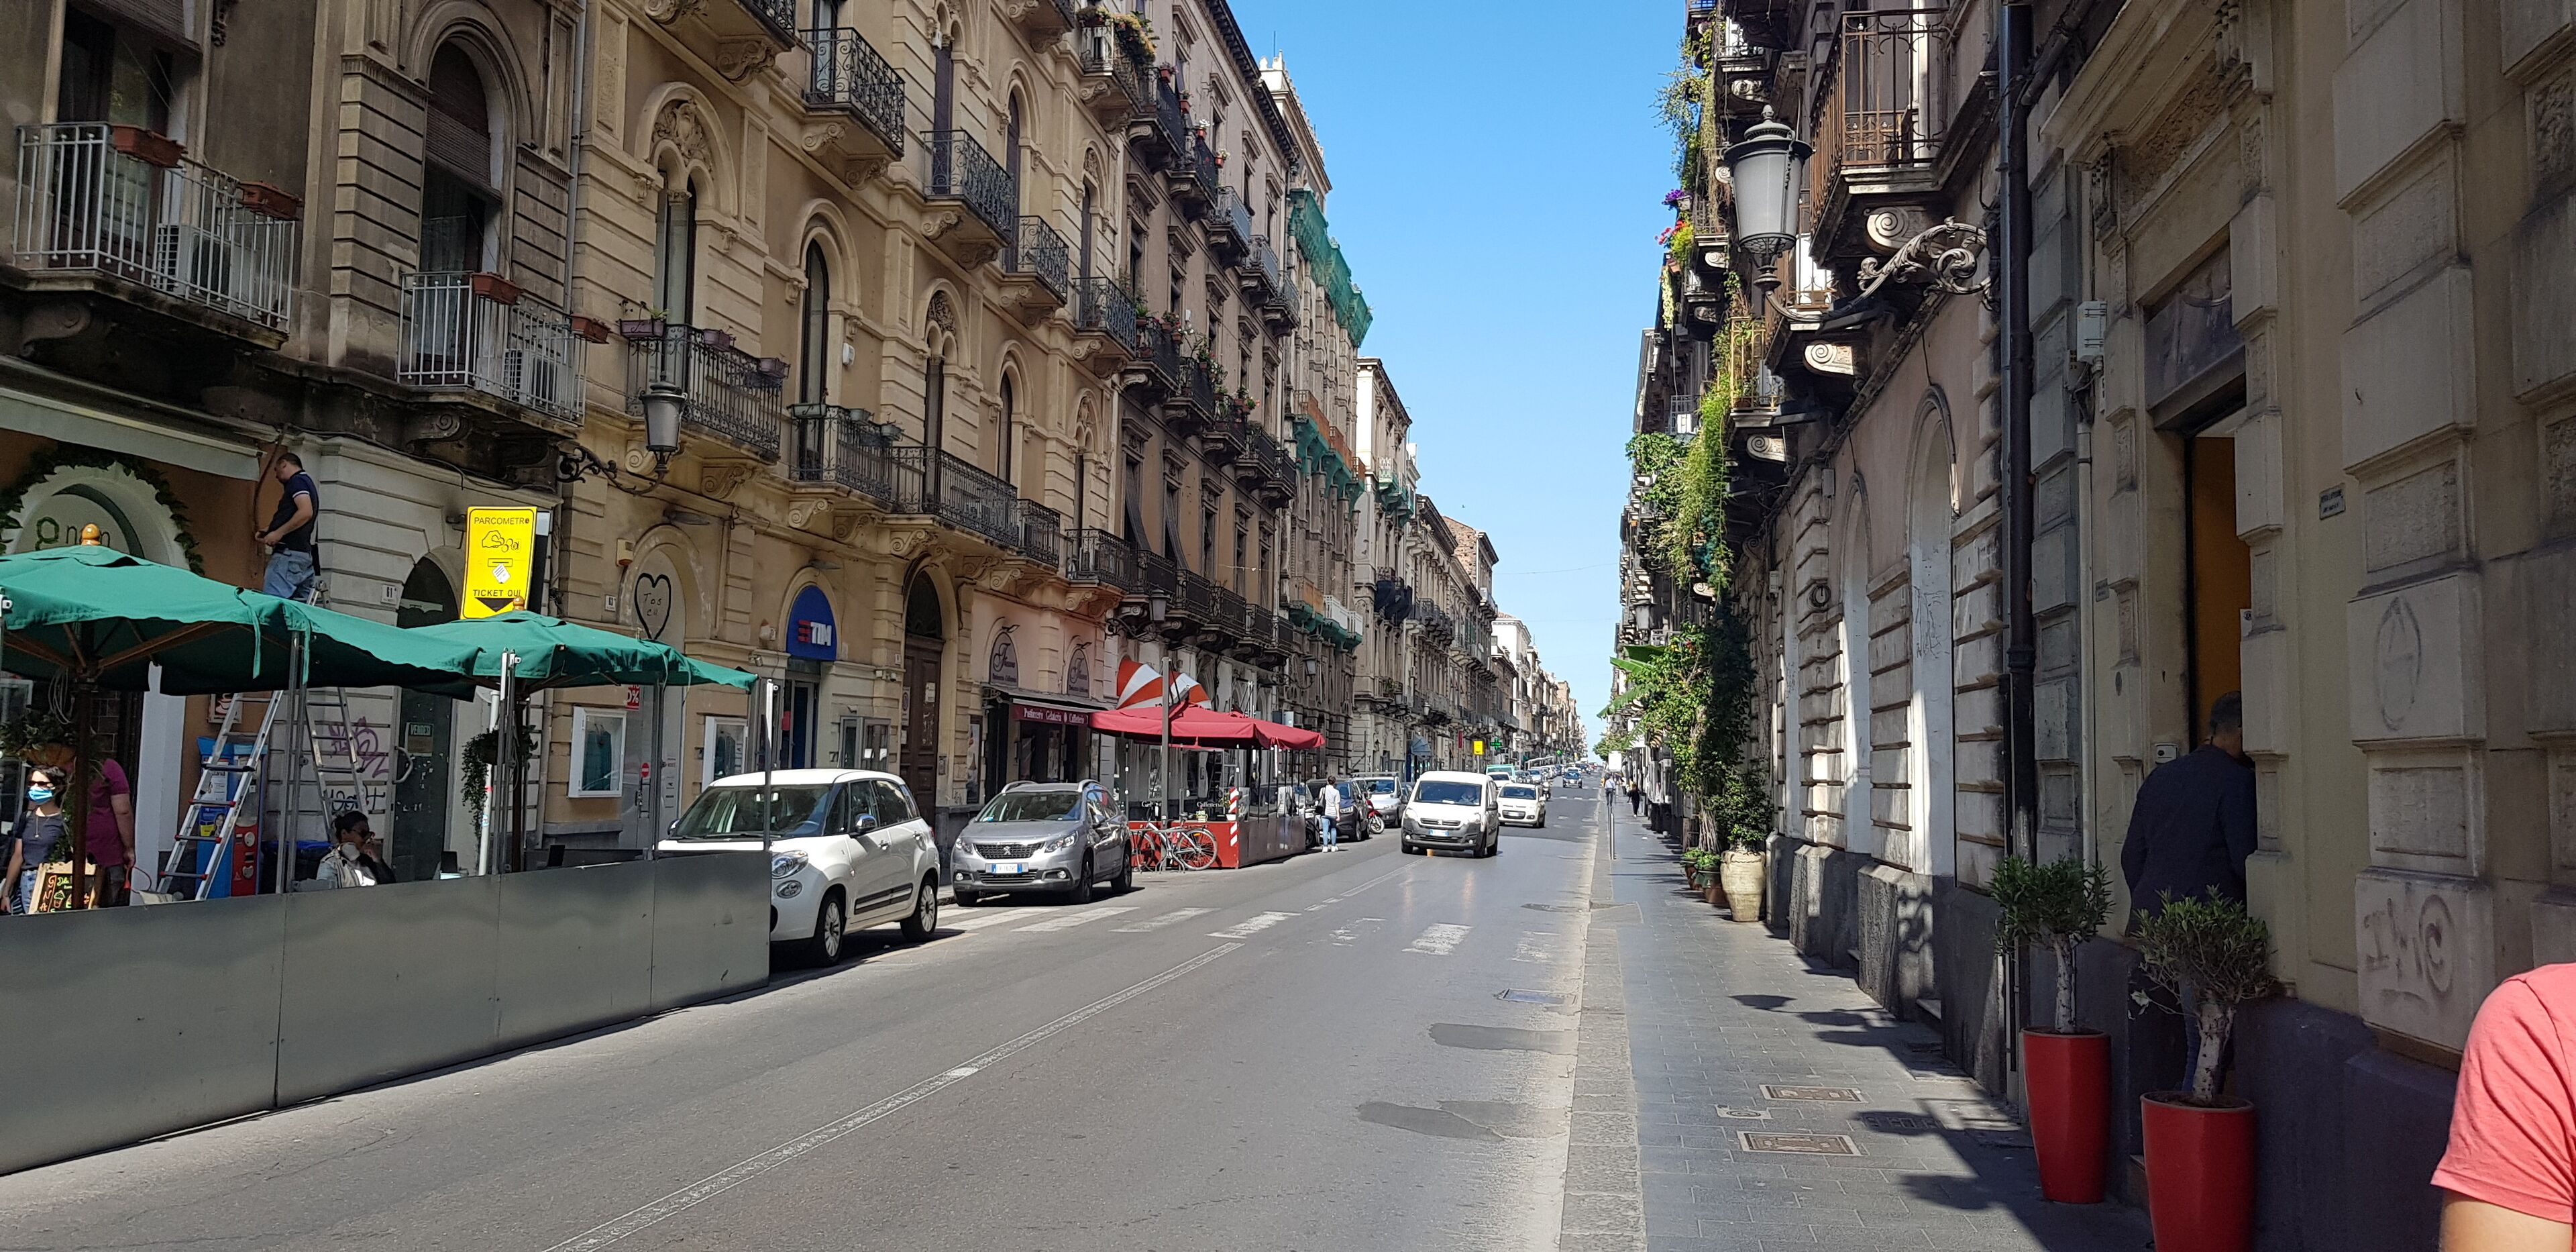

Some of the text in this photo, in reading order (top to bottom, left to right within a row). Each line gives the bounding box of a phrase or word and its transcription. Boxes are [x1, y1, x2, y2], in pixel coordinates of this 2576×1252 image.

[474, 517, 530, 525] PARCOMETRO
[473, 589, 521, 597] TICKET QUI
